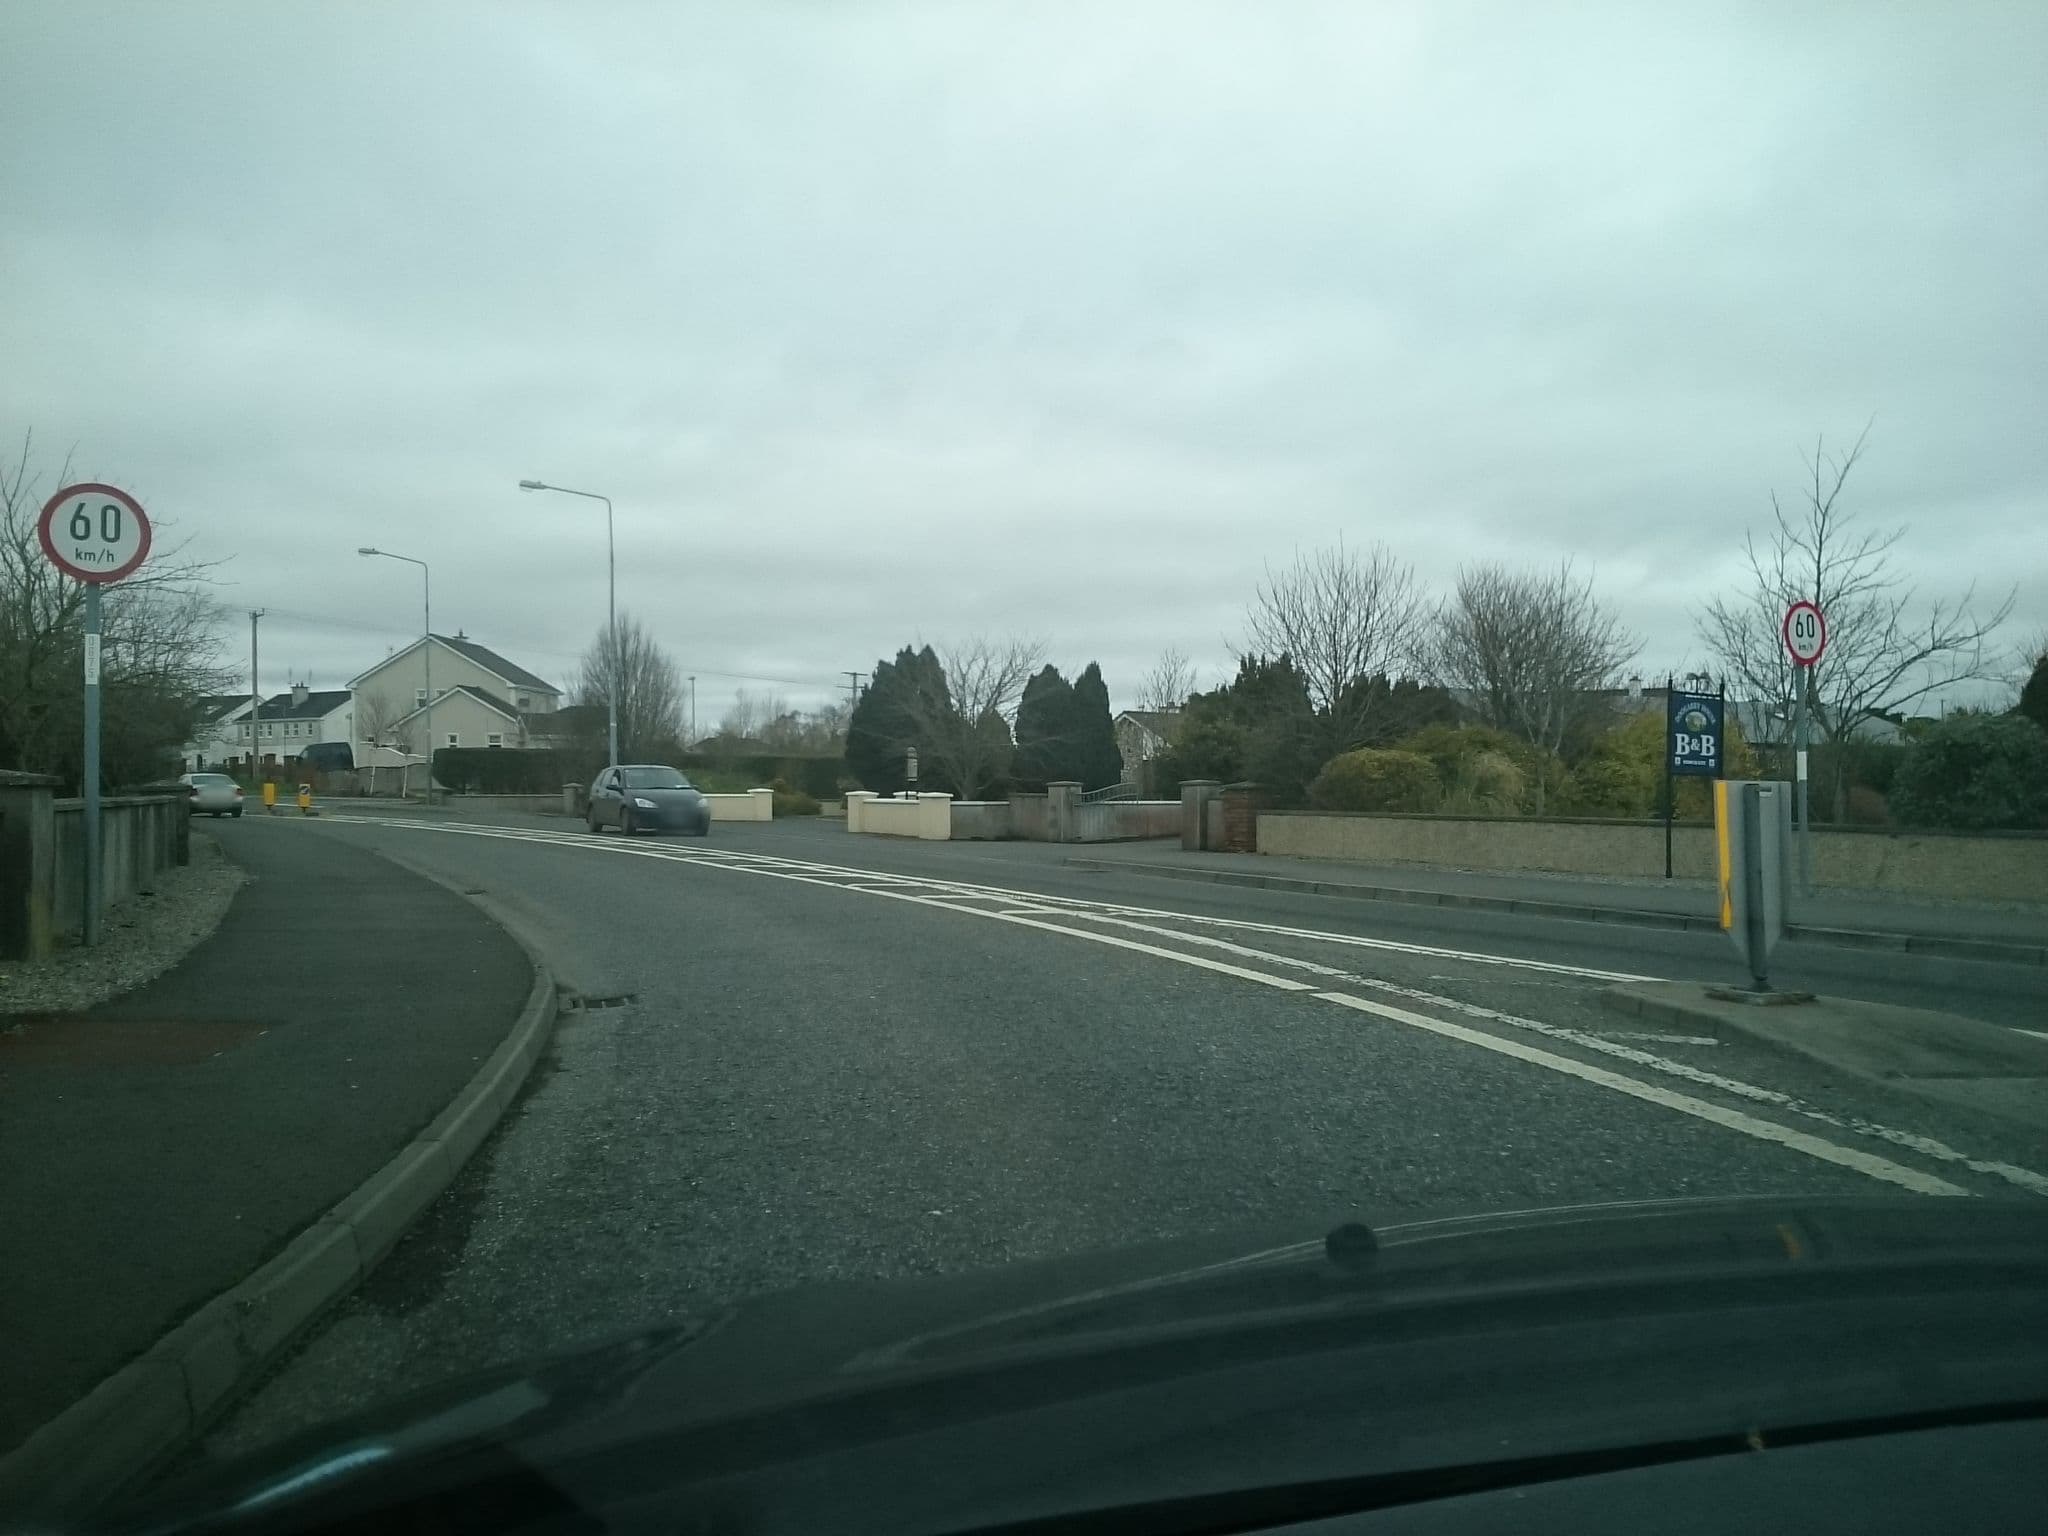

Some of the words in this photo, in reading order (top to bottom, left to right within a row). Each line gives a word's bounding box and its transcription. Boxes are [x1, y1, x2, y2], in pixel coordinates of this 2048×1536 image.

[69, 502, 121, 543] 60
[75, 547, 114, 563] km/h
[1795, 613, 1815, 638] 60
[1675, 733, 1715, 756] B&B
